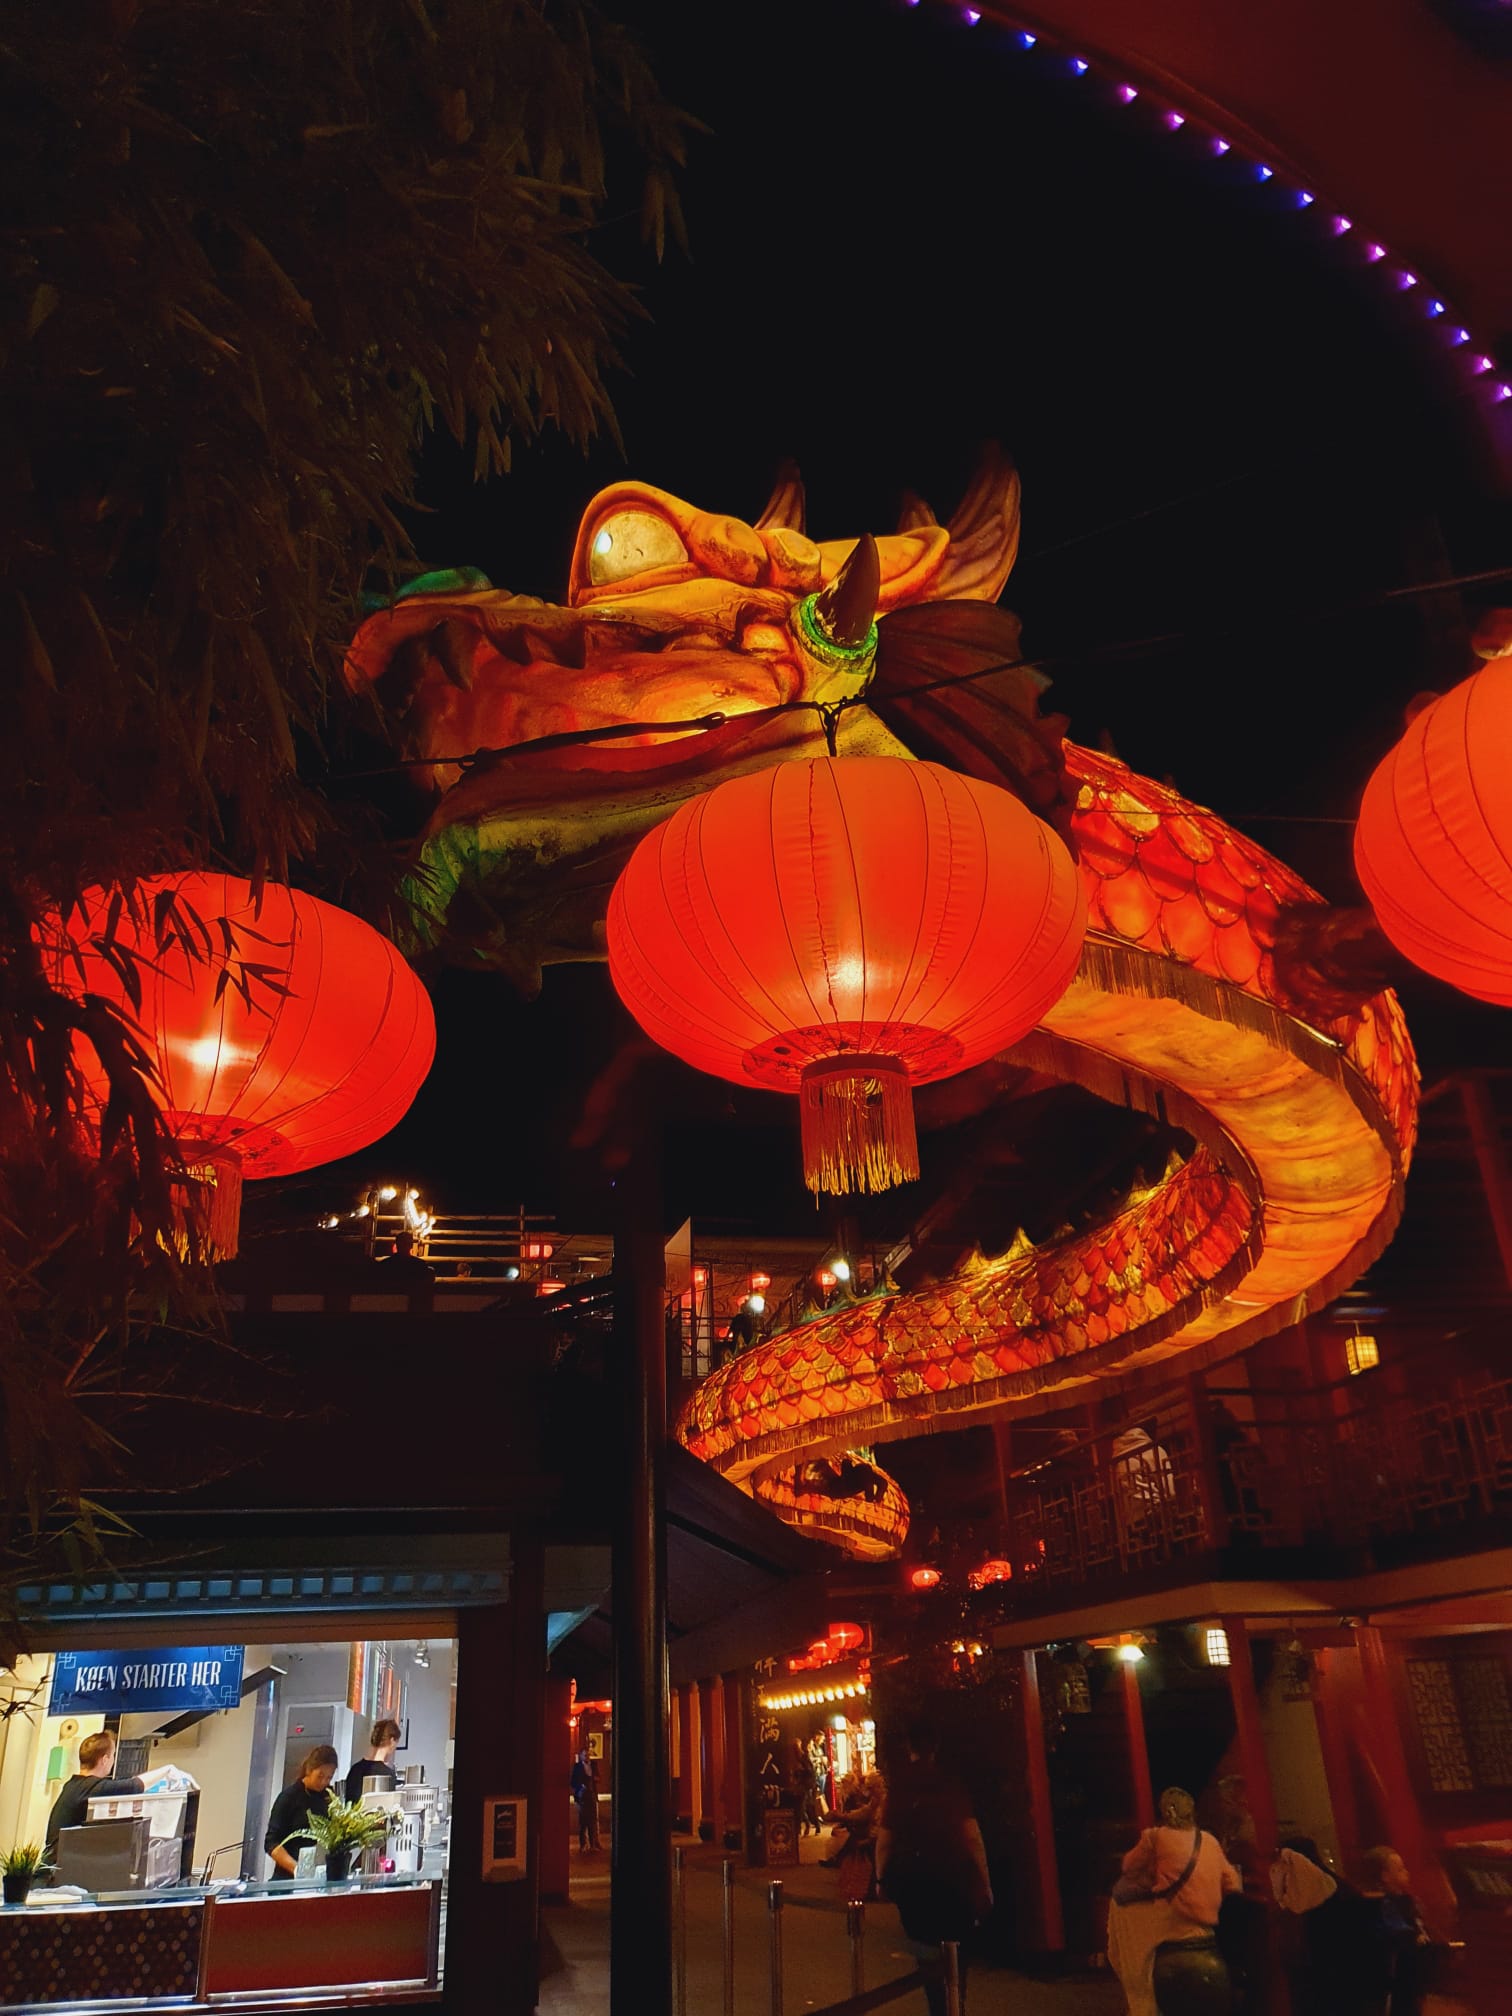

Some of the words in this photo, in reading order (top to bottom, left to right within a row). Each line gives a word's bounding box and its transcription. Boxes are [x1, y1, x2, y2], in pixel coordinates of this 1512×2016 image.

[75, 1666, 118, 1692] KØEN
[122, 1662, 187, 1689] STARTER
[191, 1661, 222, 1686] HER
